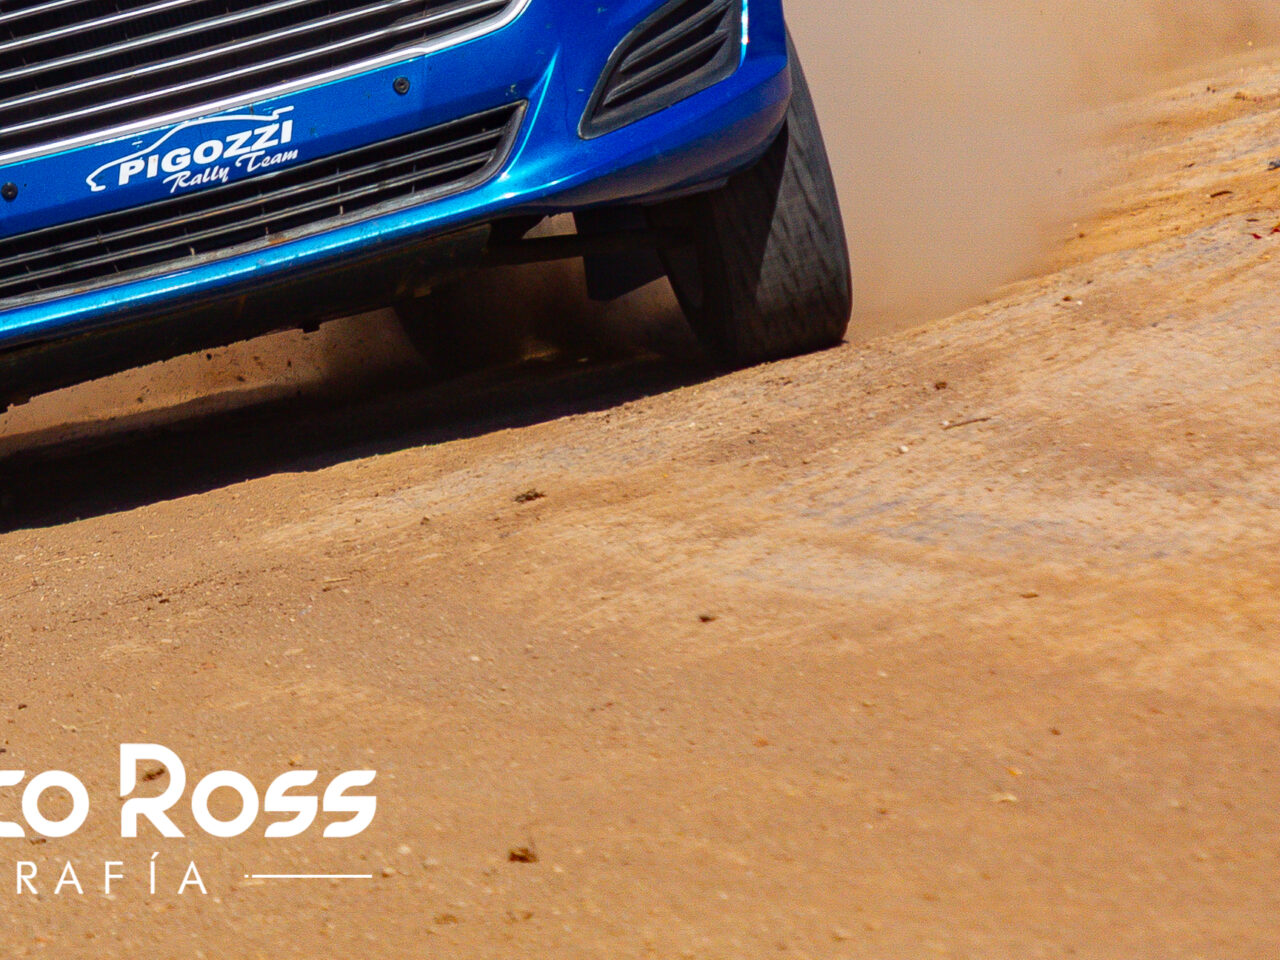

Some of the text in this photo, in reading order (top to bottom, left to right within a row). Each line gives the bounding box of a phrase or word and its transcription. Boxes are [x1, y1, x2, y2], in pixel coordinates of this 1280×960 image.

[118, 119, 293, 186] PIGOZZI
[162, 149, 299, 194] Rally Team
